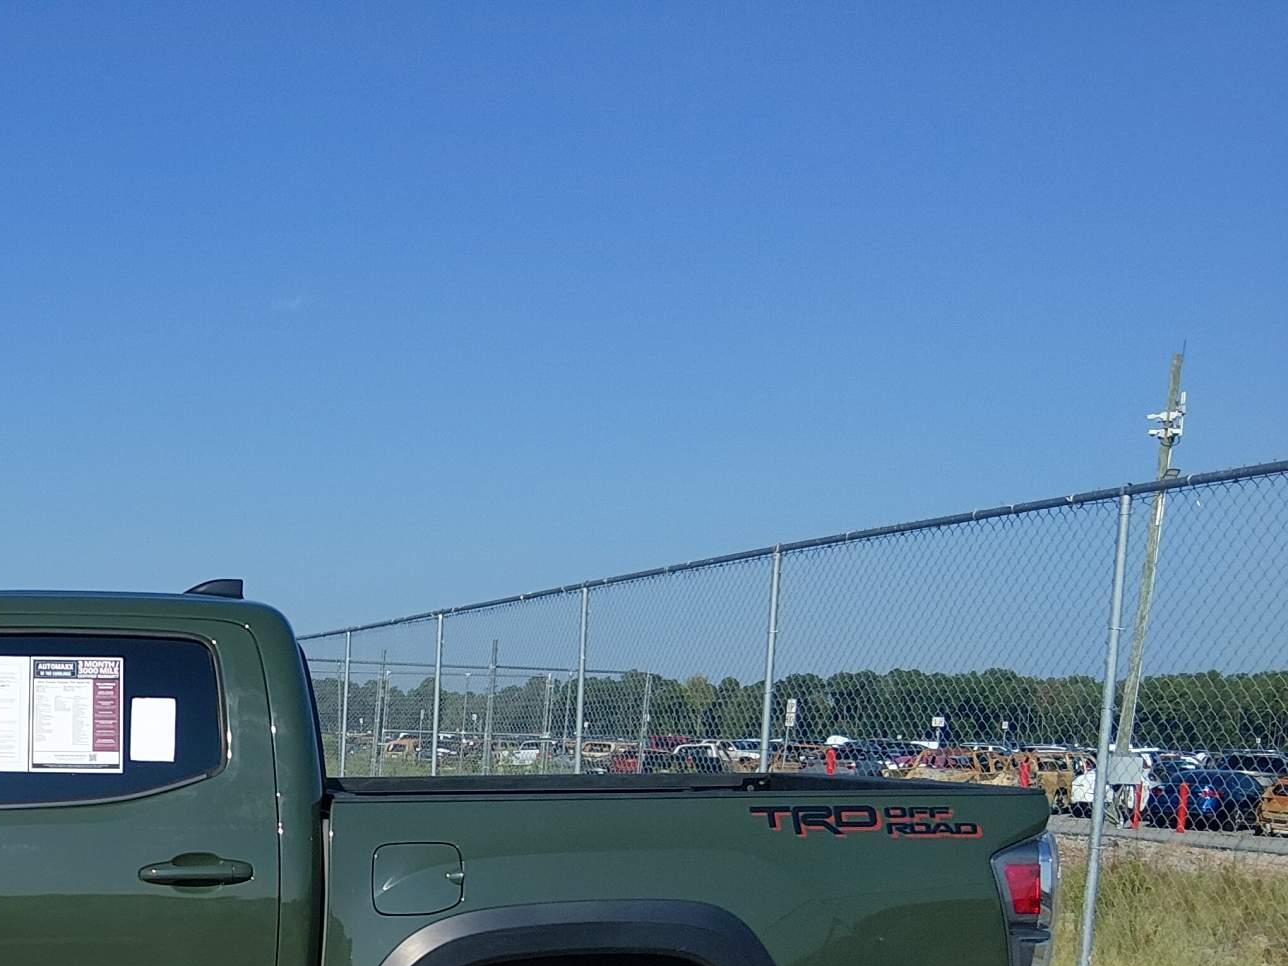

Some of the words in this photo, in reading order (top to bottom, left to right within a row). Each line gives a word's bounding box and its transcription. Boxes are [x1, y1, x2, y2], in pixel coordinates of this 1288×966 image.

[749, 805, 882, 837] TRD
[884, 806, 954, 821] OFF
[887, 822, 983, 838] ROAD
